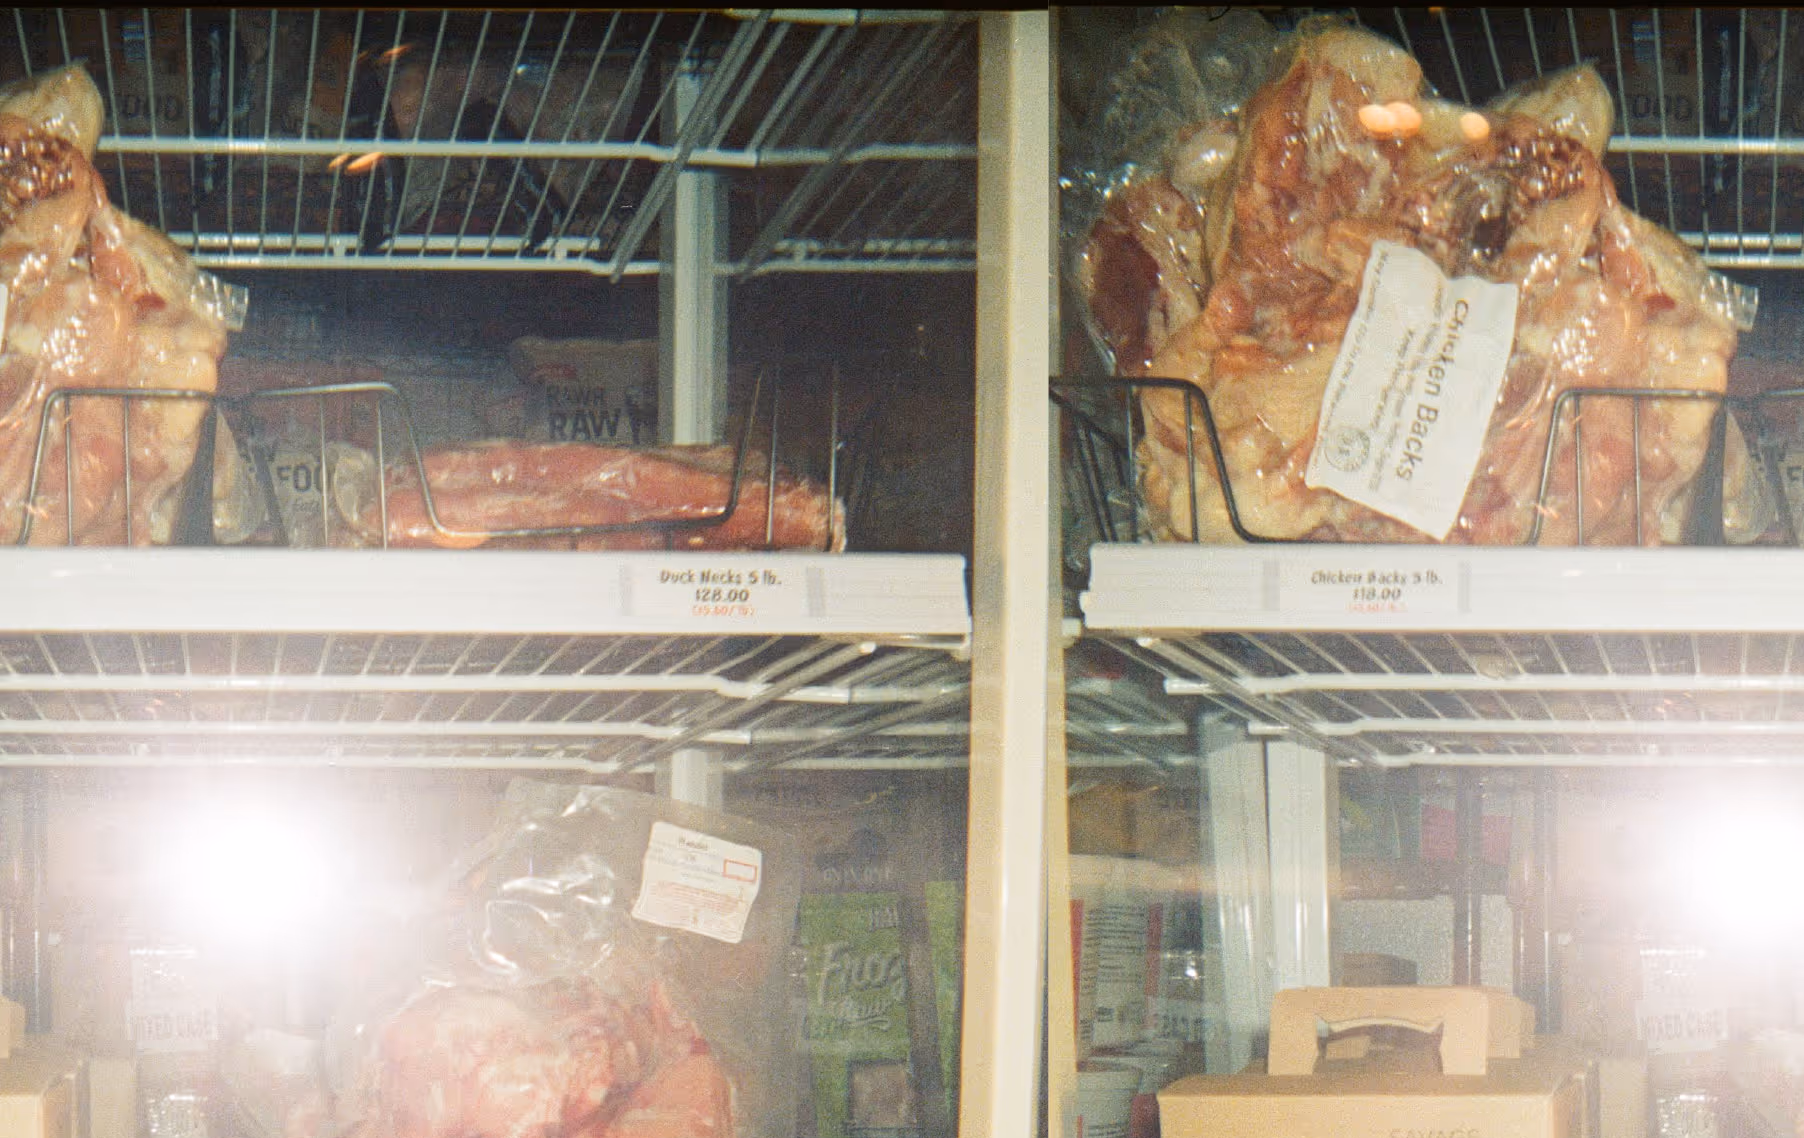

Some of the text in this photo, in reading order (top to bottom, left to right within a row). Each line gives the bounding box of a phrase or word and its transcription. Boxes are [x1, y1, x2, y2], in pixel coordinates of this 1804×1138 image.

[1425, 298, 1469, 398] Chicken
[549, 408, 621, 441] RAW
[1396, 405, 1440, 482] Backs
[276, 463, 332, 493] FOO
[659, 568, 783, 586] Duck Necks 5 lb.
[1311, 569, 1362, 585] Chicken
[1367, 569, 1408, 585] Backs
